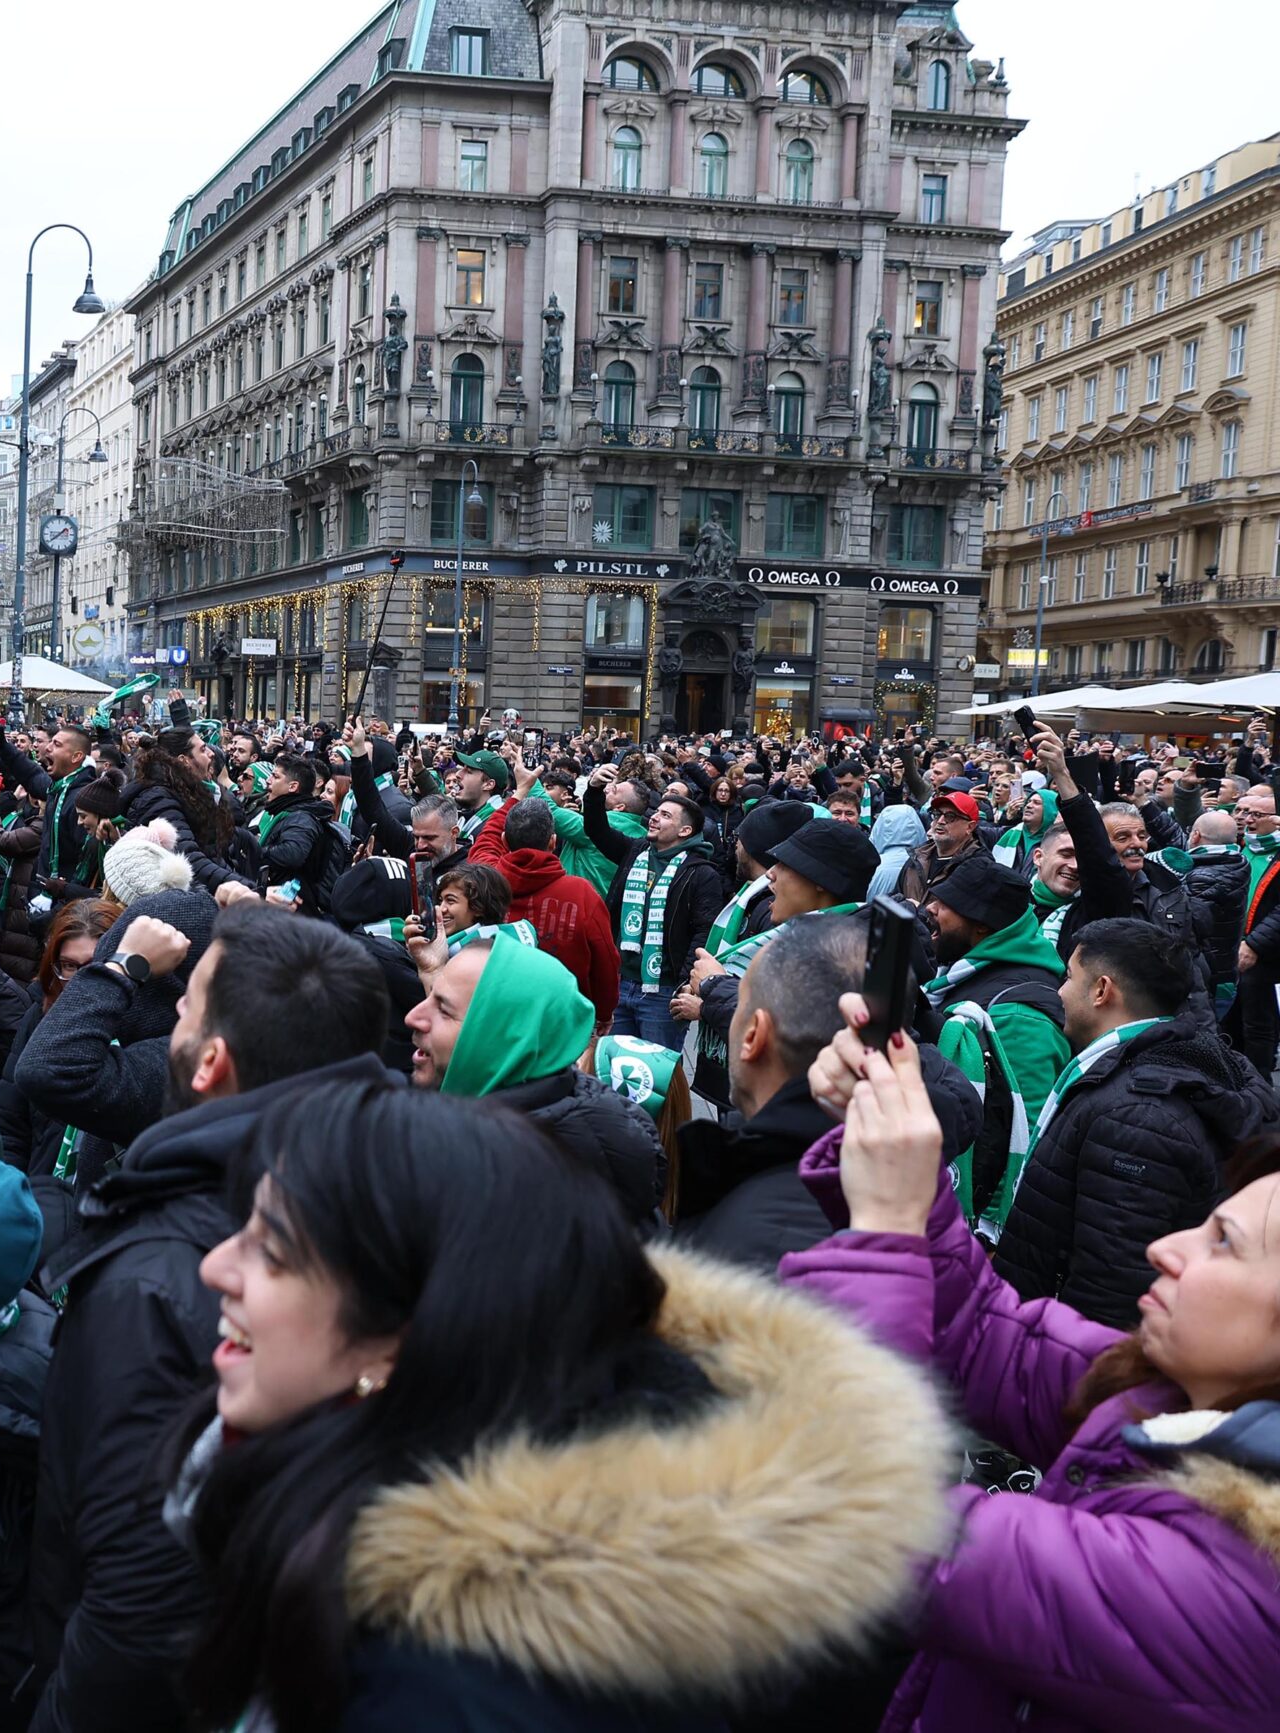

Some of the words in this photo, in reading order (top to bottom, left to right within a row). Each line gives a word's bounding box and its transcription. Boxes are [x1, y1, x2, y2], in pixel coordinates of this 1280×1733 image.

[575, 560, 649, 576] PILSTL
[768, 571, 821, 585] OMEGA
[889, 580, 940, 594] OMEGA
[172, 649, 186, 662] U
